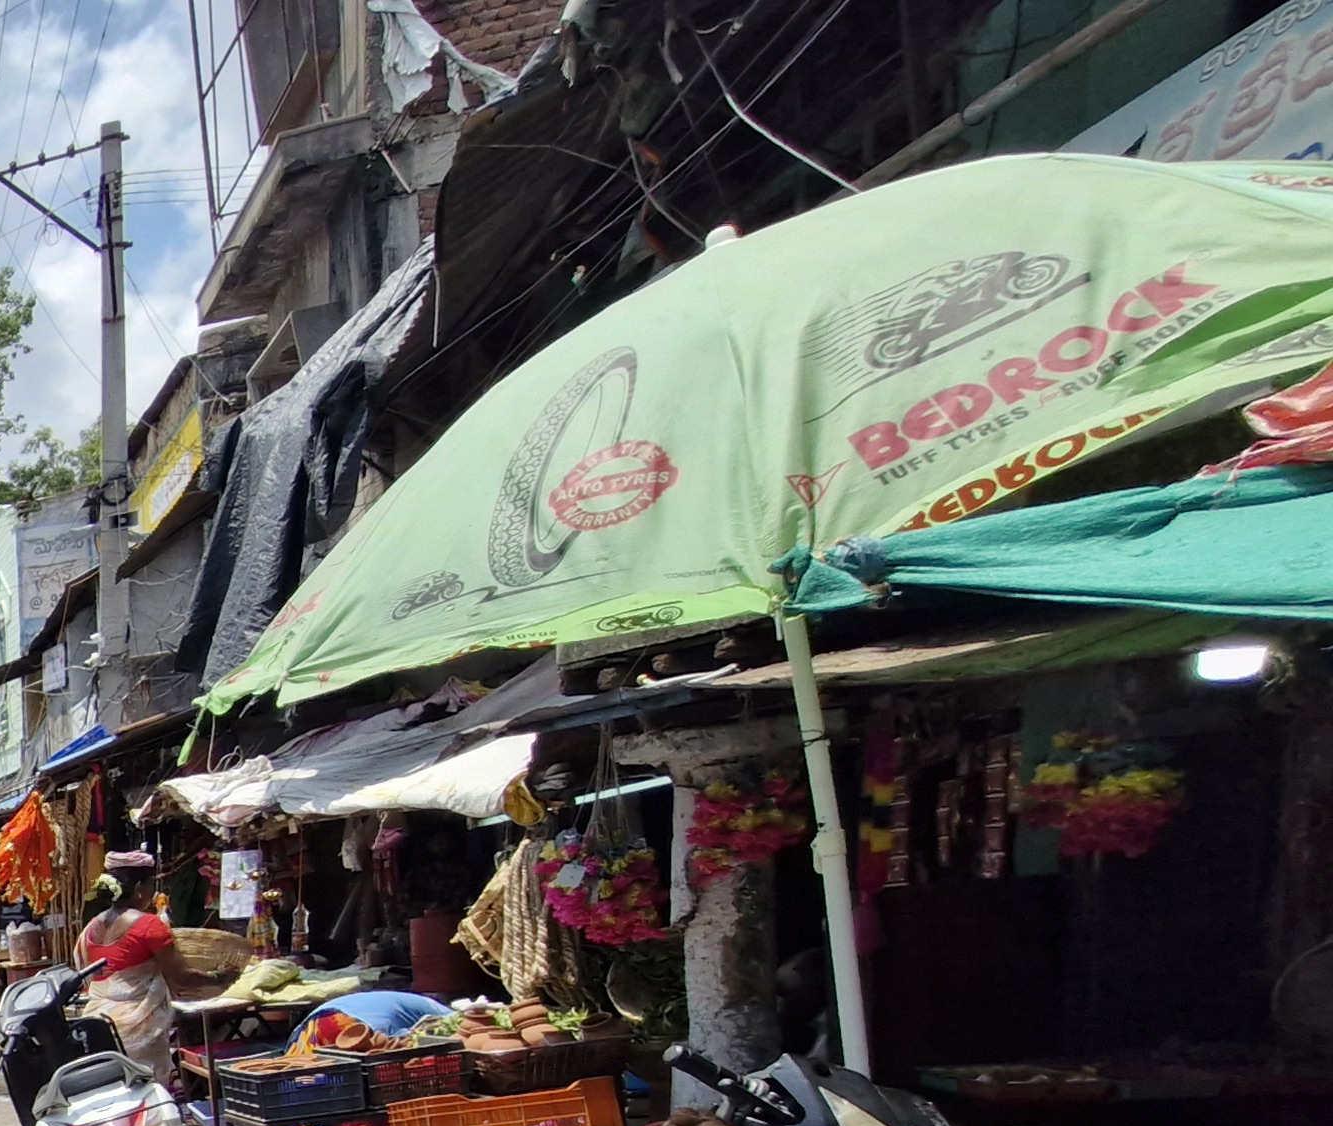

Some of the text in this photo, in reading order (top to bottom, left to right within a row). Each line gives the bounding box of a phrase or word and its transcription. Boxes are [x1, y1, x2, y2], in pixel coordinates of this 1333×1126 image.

[848, 260, 1221, 471] BEDROCK
[873, 449, 938, 486] TUFF
[944, 405, 1031, 451] TYRES
[1137, 288, 1232, 352] ROADS
[555, 470, 671, 503] AUTO TYRES
[562, 488, 654, 527] WARRANTY
